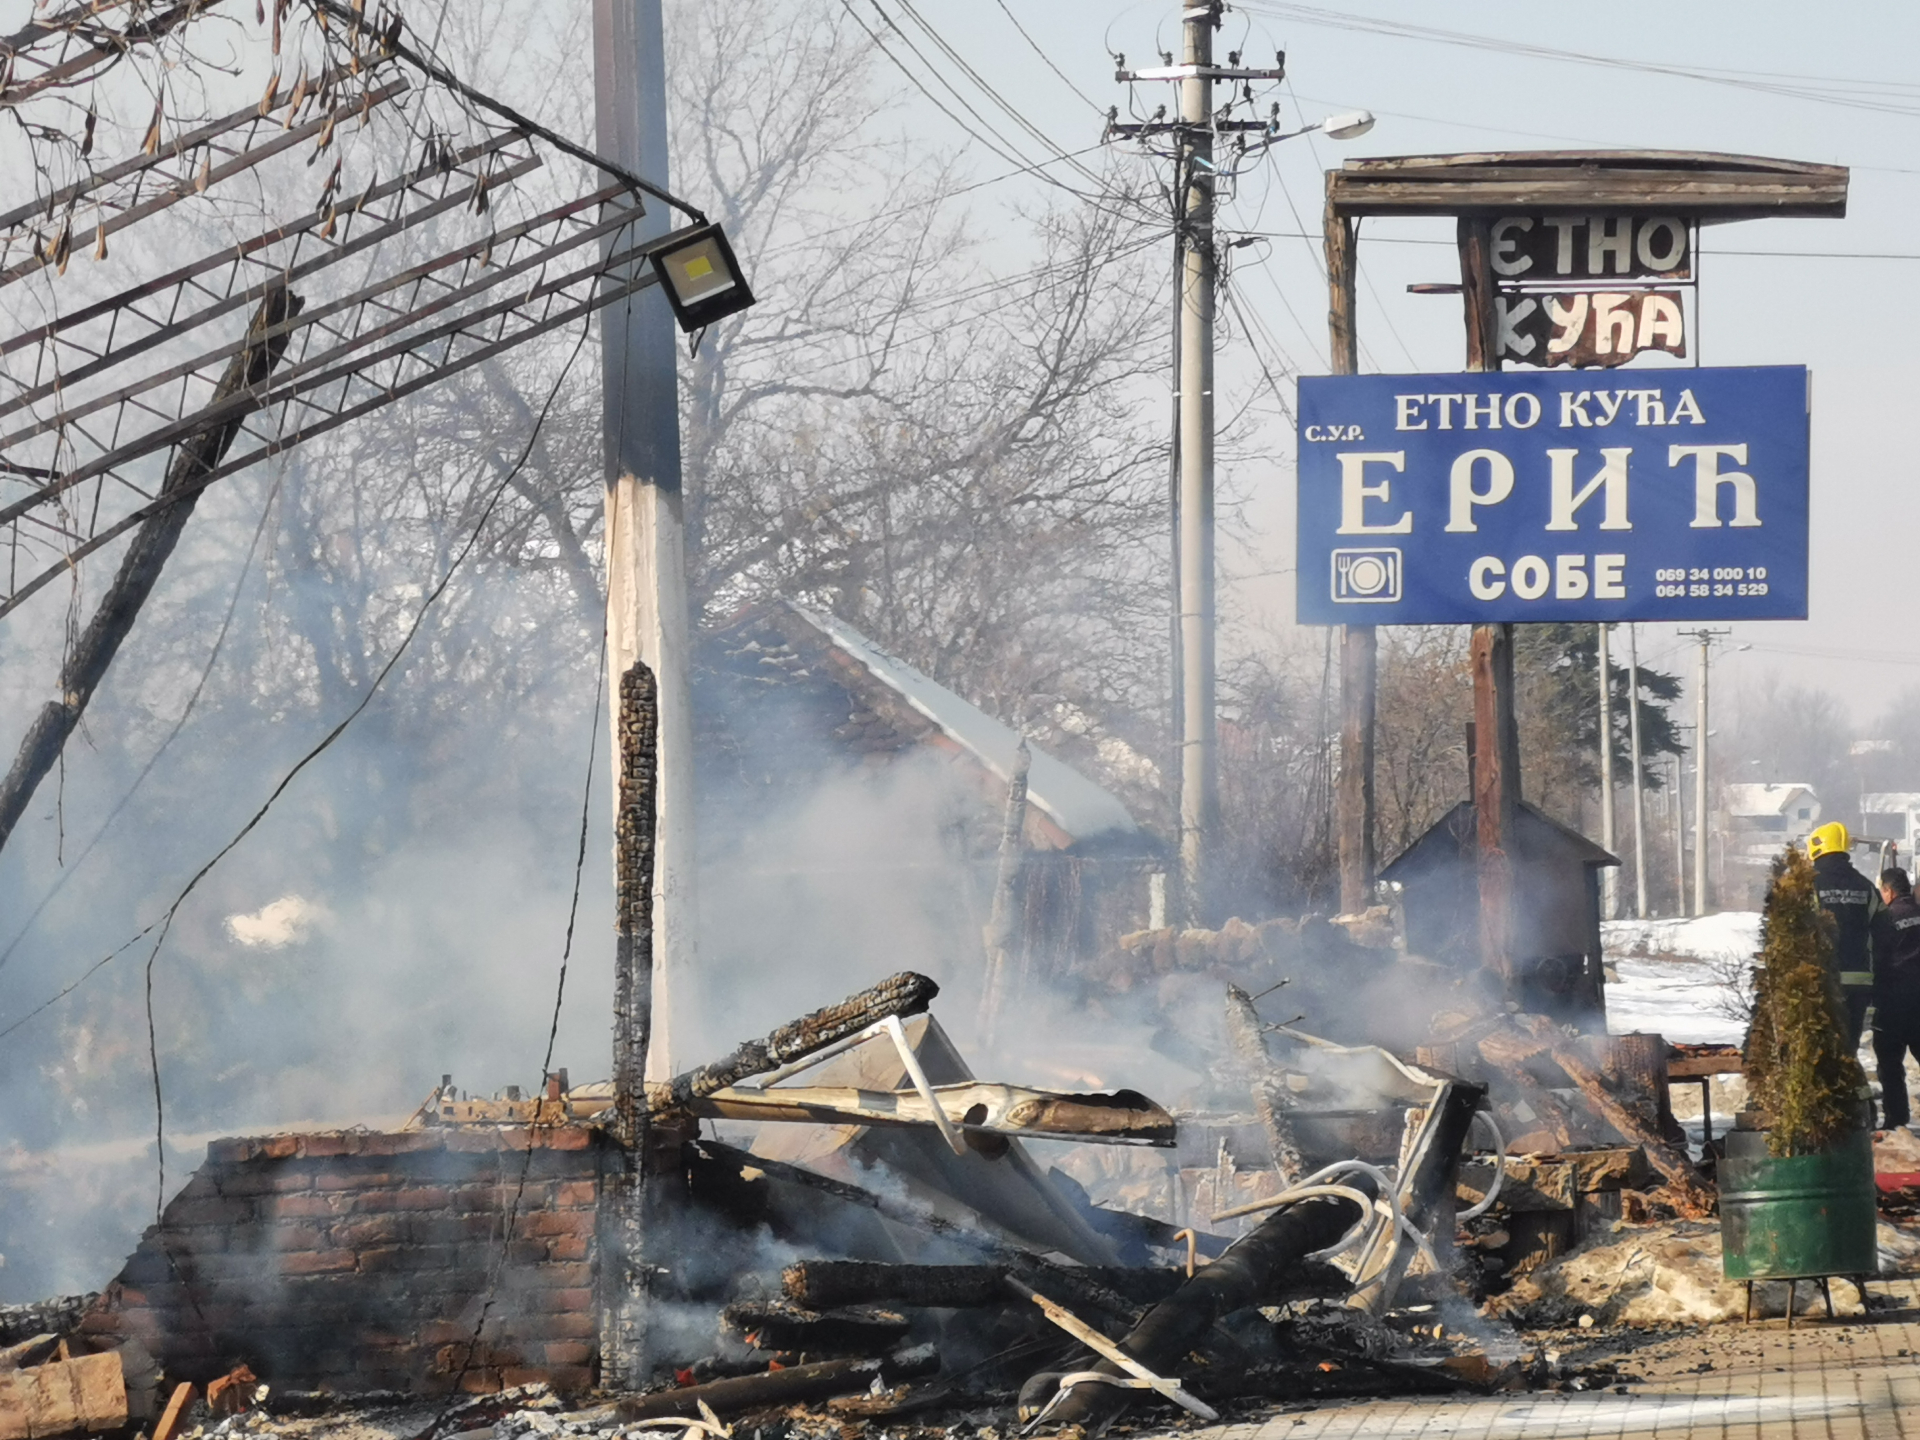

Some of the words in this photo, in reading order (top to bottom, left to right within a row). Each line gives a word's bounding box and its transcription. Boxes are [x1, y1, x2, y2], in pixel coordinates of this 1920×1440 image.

[1495, 293, 1683, 356] КУЋА
[1395, 392, 1541, 430] ЕТНО
[1559, 389, 1706, 427] КУЋА
[1336, 444, 1762, 534] ЕРИЋ
[1469, 554, 1626, 600] СОБЕ
[1656, 569, 1686, 581] 069
[1689, 568, 1709, 580] 34
[1713, 568, 1743, 580] 000
[1746, 567, 1767, 579] 10
[1656, 585, 1686, 597] 064
[1689, 584, 1710, 597] 58
[1713, 584, 1734, 596] 34
[1737, 583, 1768, 596] 529
